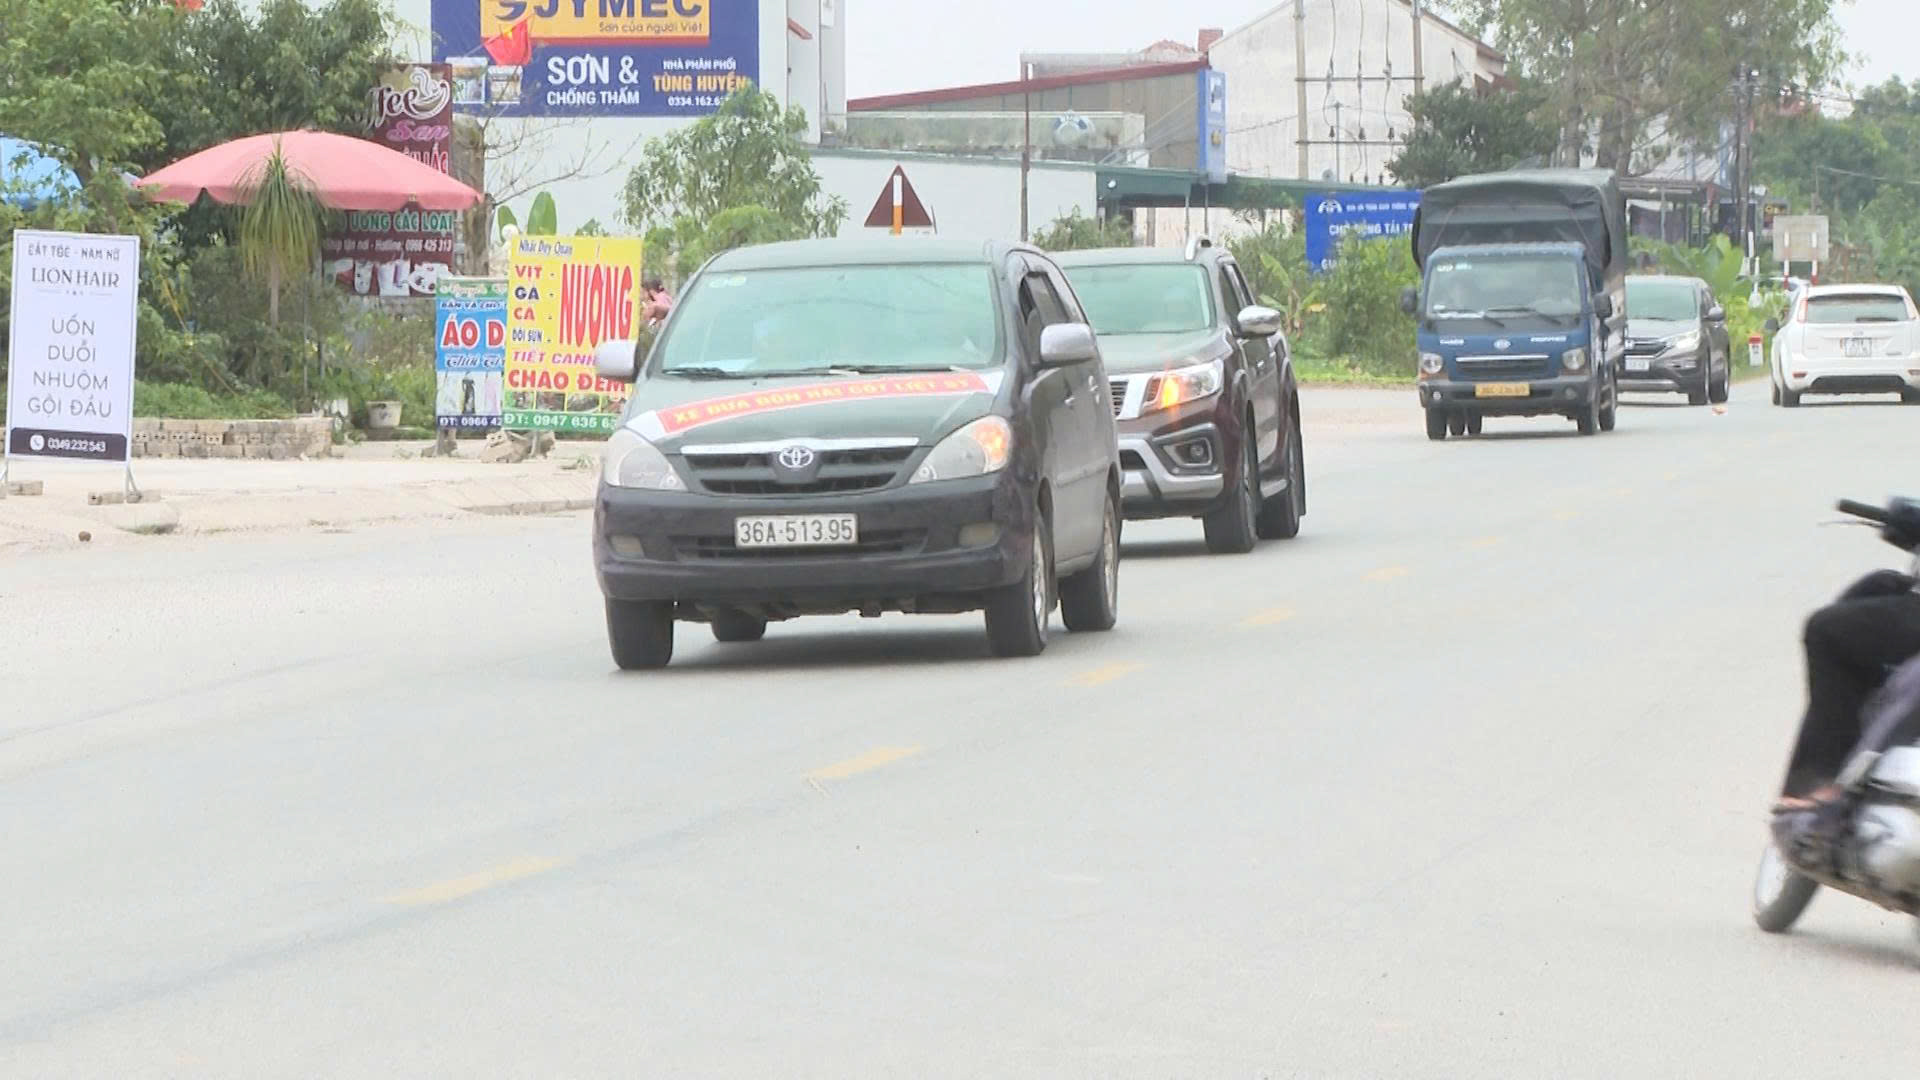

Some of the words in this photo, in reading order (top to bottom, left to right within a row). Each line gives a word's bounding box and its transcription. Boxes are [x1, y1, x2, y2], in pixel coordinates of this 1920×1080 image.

[547, 54, 610, 85] SƠN
[618, 55, 640, 85] &
[663, 57, 684, 70] NHÀ
[685, 57, 712, 70] PHÂN
[713, 56, 736, 70] PHỐI
[653, 71, 693, 92] TÙNG
[546, 86, 597, 106] CHỐNG
[599, 86, 640, 106] THẤM
[393, 207, 419, 232] CÁC
[421, 211, 453, 237] LOẠI
[28, 241, 48, 256] CẮT
[81, 247, 103, 260] NAM
[31, 267, 72, 284] LION
[76, 269, 120, 288] HAIR
[52, 313, 95, 336] UỐN
[442, 313, 480, 348] ÁO
[486, 319, 506, 348] D
[33, 369, 108, 391] NHUỘM
[28, 393, 62, 418] GỘI
[504, 412, 529, 425] ĐT:
[533, 414, 567, 427] 0947
[571, 415, 597, 429] 635
[739, 519, 853, 543] 36A-513.95
